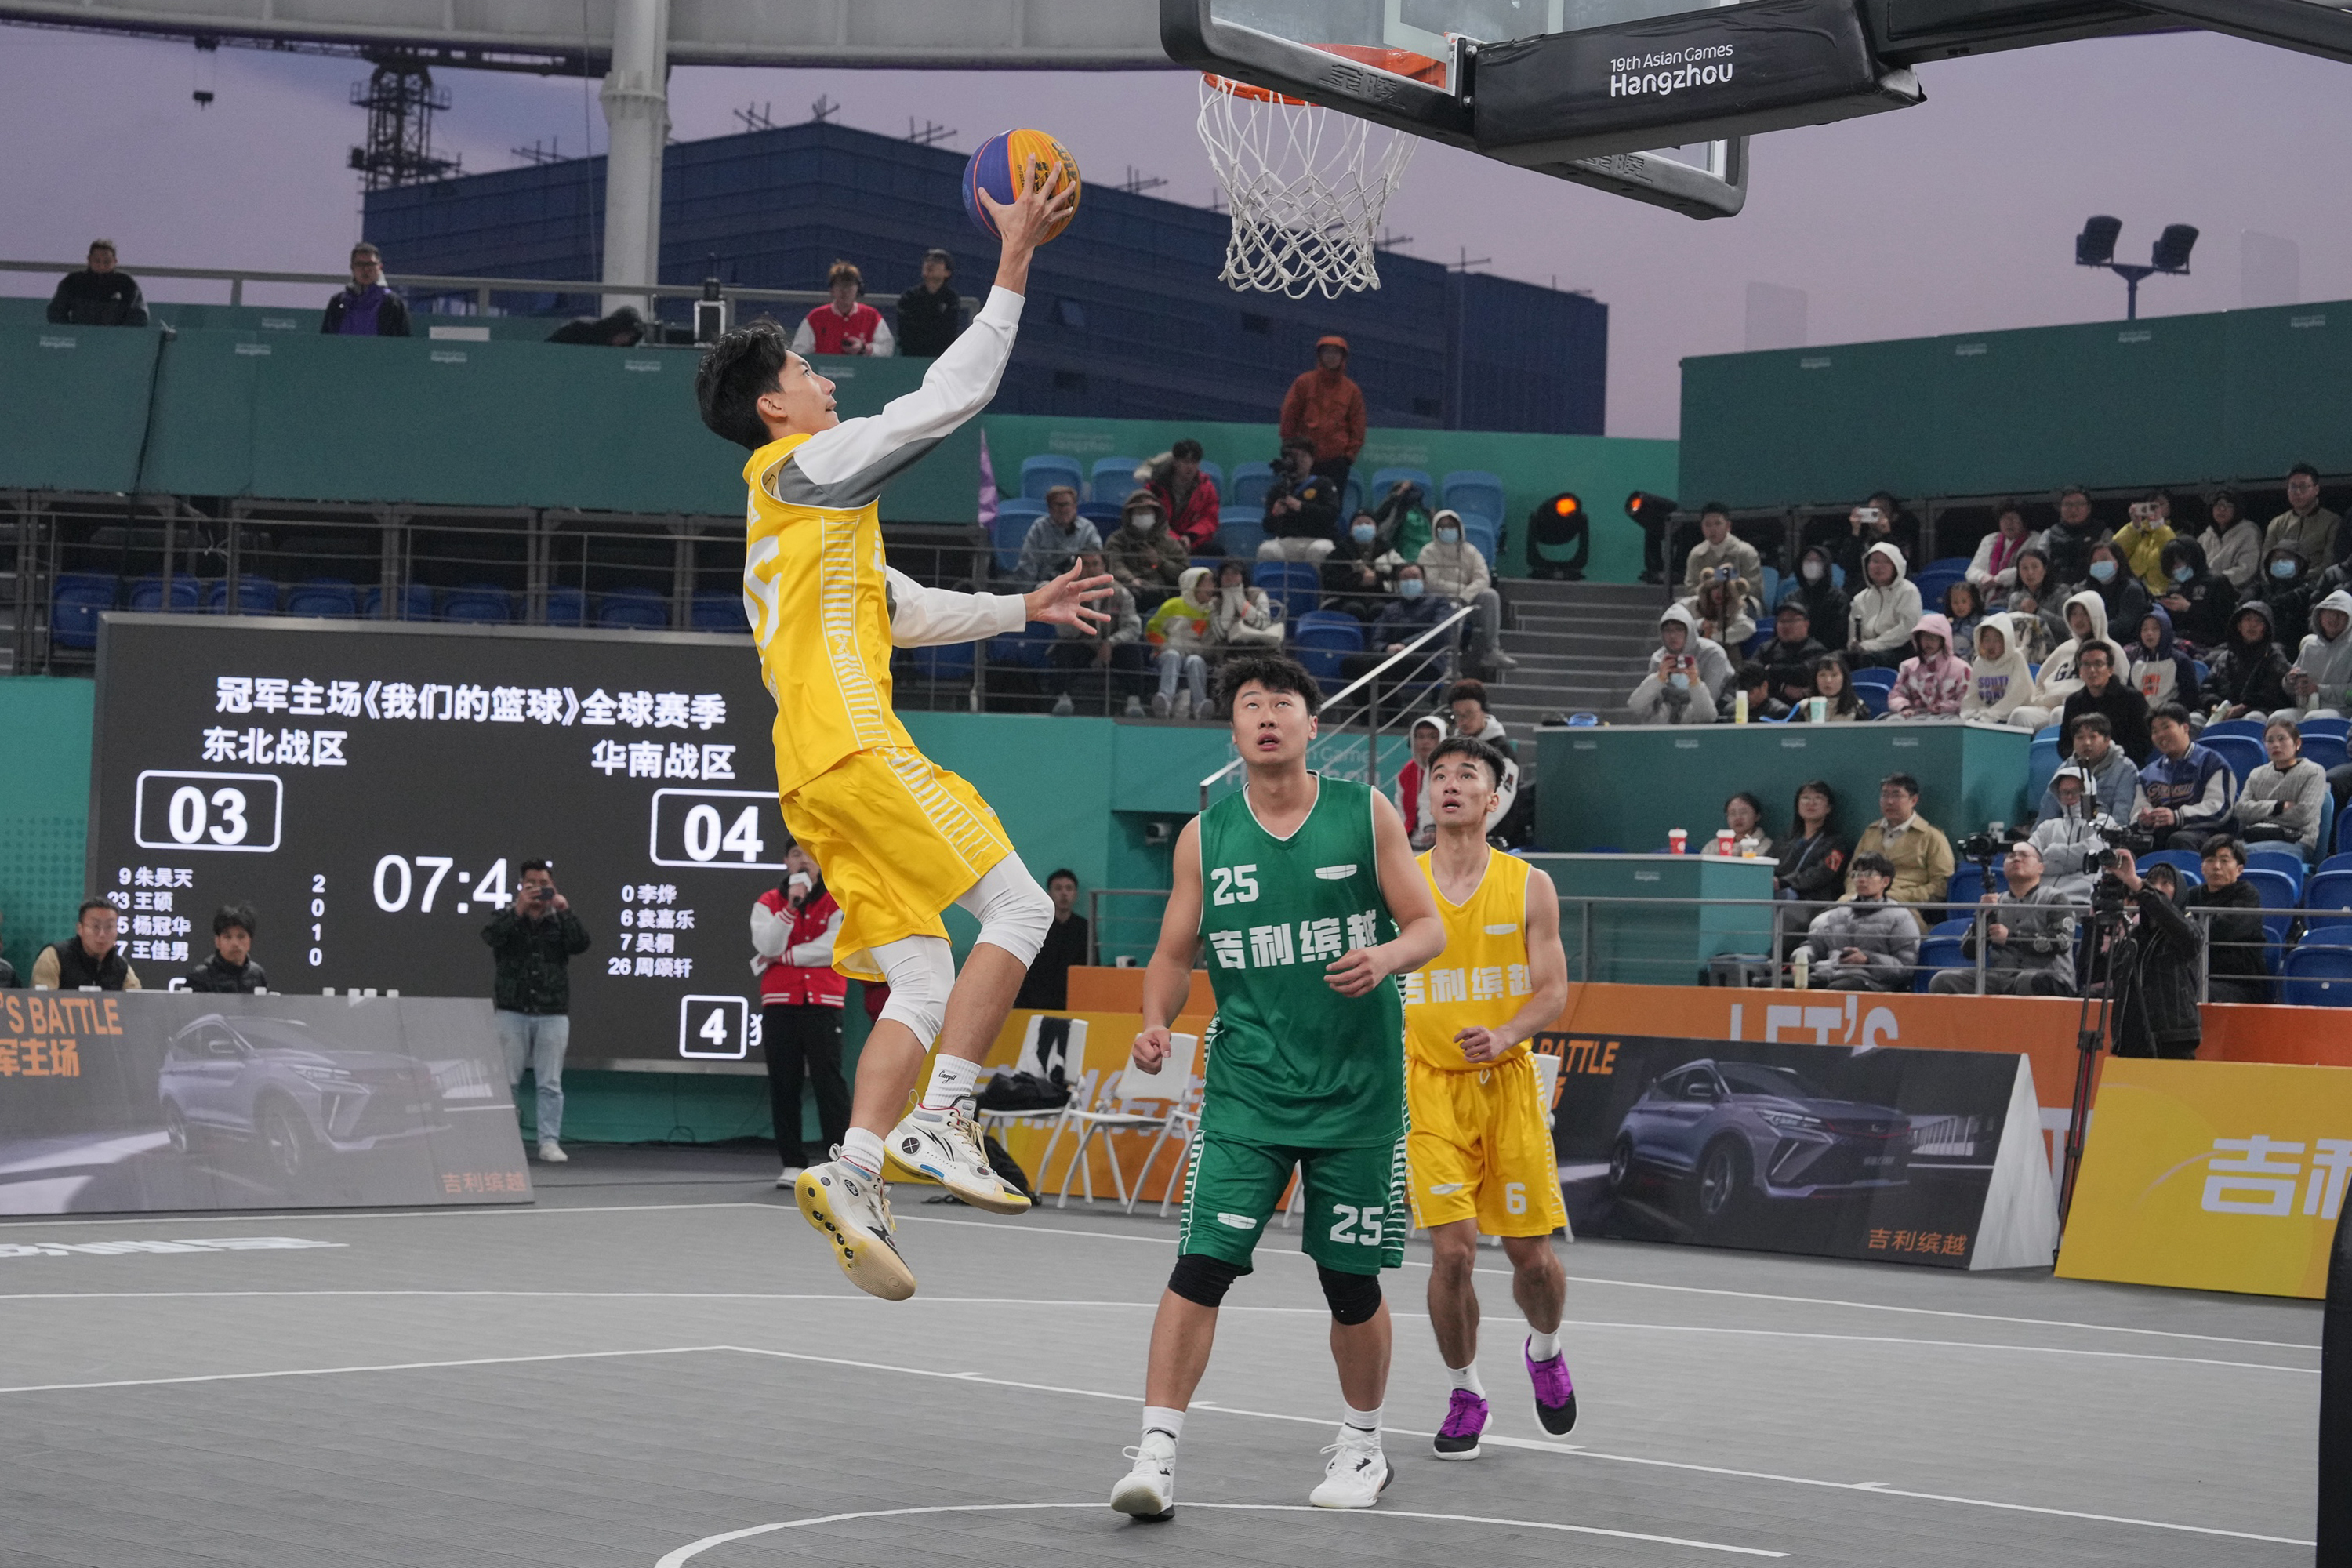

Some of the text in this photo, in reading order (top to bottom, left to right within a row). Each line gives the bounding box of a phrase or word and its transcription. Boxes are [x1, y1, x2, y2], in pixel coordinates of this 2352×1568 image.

[1610, 44, 1733, 73] 19th Asian Games
[1610, 63, 1733, 97] Hangzhou
[216, 677, 727, 729] 冠军主场《我们的篮球》全球赛季
[202, 727, 348, 768] 东北战区
[592, 739, 737, 781] 华南战区
[169, 786, 249, 846] 03
[684, 804, 764, 863] 04
[119, 867, 132, 885] 9
[312, 874, 326, 893] 2
[373, 854, 553, 914] 07:4
[1210, 864, 1259, 906] 25
[311, 898, 325, 917] 0
[622, 884, 635, 902] 0
[132, 914, 191, 937] 杨冠华
[311, 923, 321, 942] 1
[620, 909, 634, 927] 6
[131, 939, 189, 962] 王佳男
[620, 933, 633, 951] 7
[1209, 909, 1378, 969] 吉利缤越
[309, 947, 322, 966] 0
[608, 957, 632, 975] 26
[27, 996, 123, 1035] BATTLE
[699, 1008, 728, 1046] 4
[1505, 1182, 1527, 1214] 6
[1330, 1203, 1384, 1247] 25
[1867, 1227, 1968, 1256] 吉利缤越
